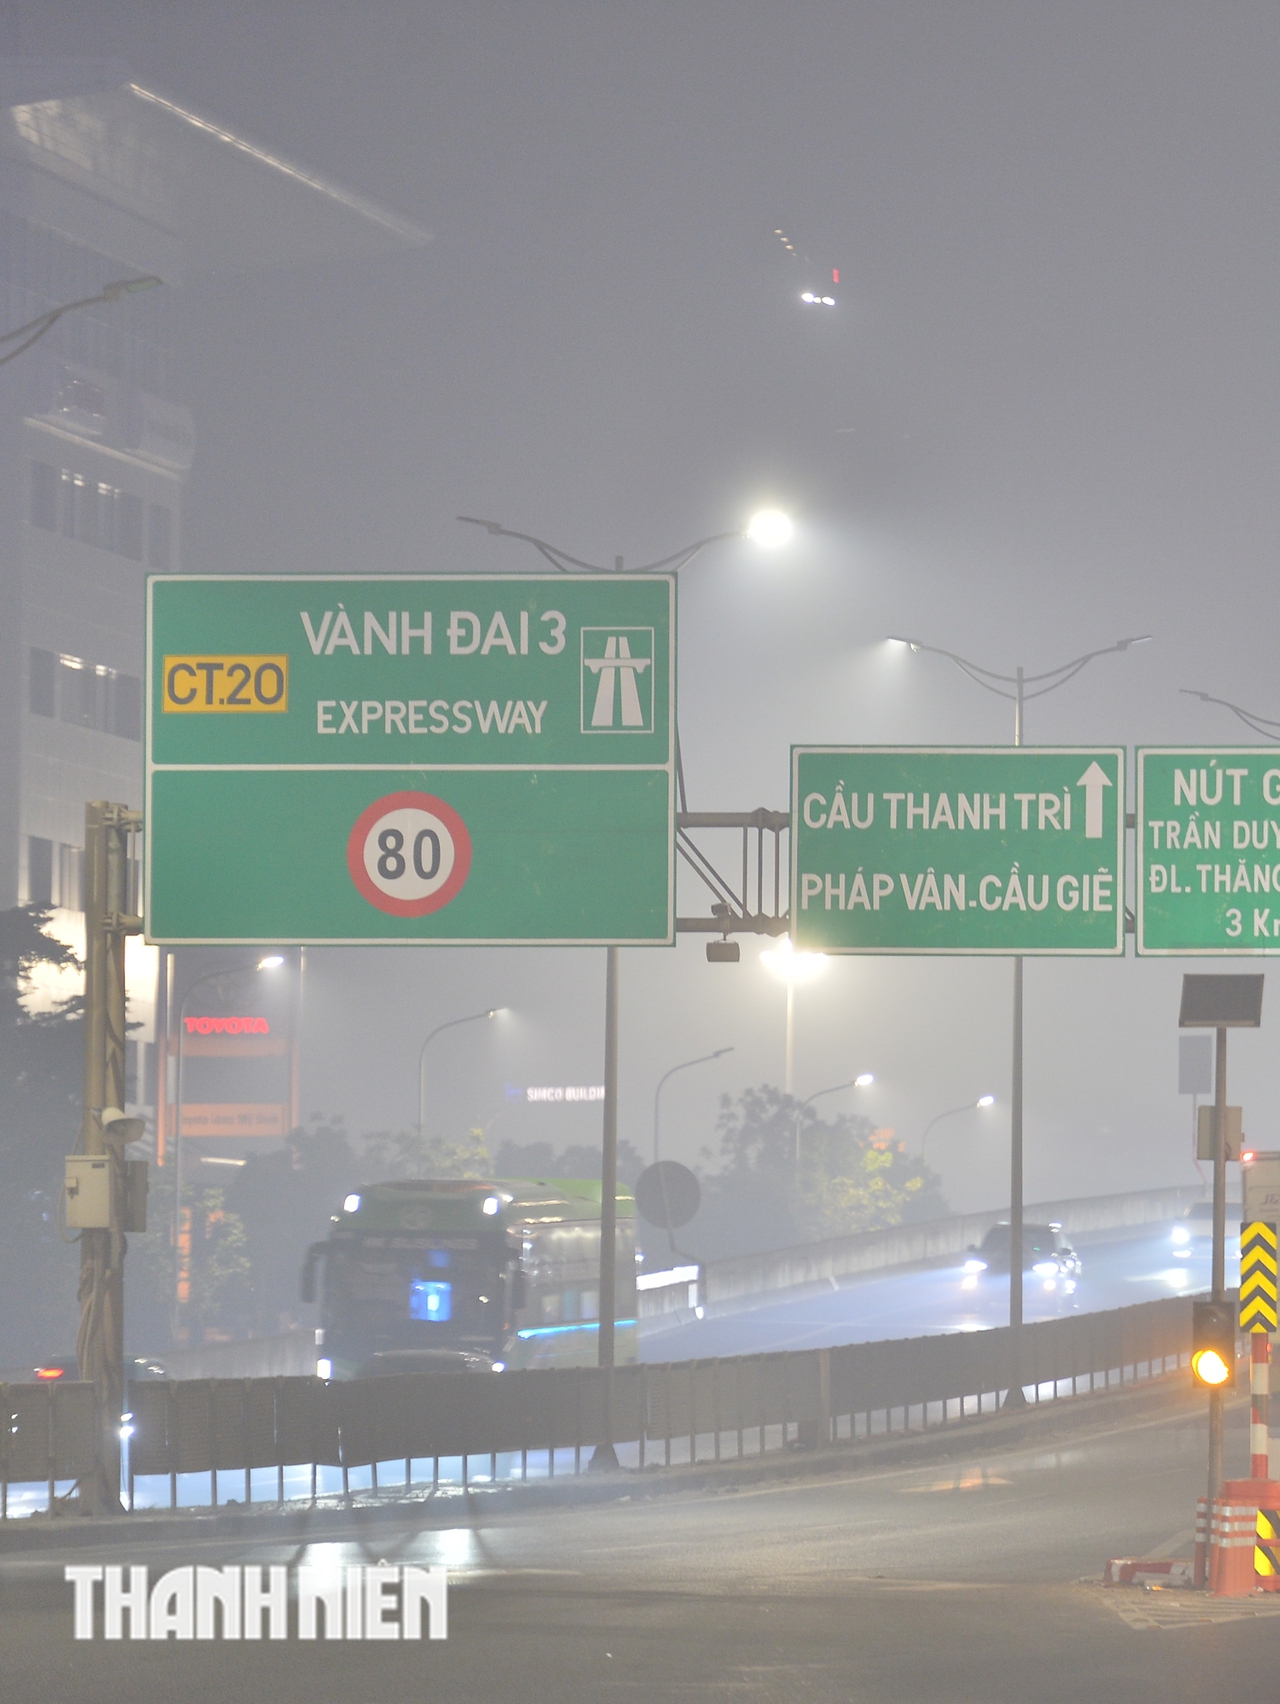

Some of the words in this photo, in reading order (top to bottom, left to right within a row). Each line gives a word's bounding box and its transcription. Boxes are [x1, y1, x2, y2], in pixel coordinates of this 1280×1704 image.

[300, 603, 432, 655] VÀNH
[446, 610, 529, 656] ĐAI
[538, 609, 567, 656] 3
[167, 662, 285, 705] CT.20
[317, 700, 548, 734] EXPRESSWAY
[1173, 759, 1248, 806] NÚT
[803, 779, 874, 829] CẦU
[882, 792, 1006, 830] THANH
[1013, 785, 1071, 830] TRÌ
[1148, 811, 1221, 849] TRẦN
[376, 828, 442, 881] 80
[801, 866, 895, 911] PHÁP
[1056, 867, 1114, 912] GIẼ
[1149, 863, 1191, 894] ĐL.
[1225, 908, 1243, 937] 3
[184, 1017, 269, 1034] TOYOTA
